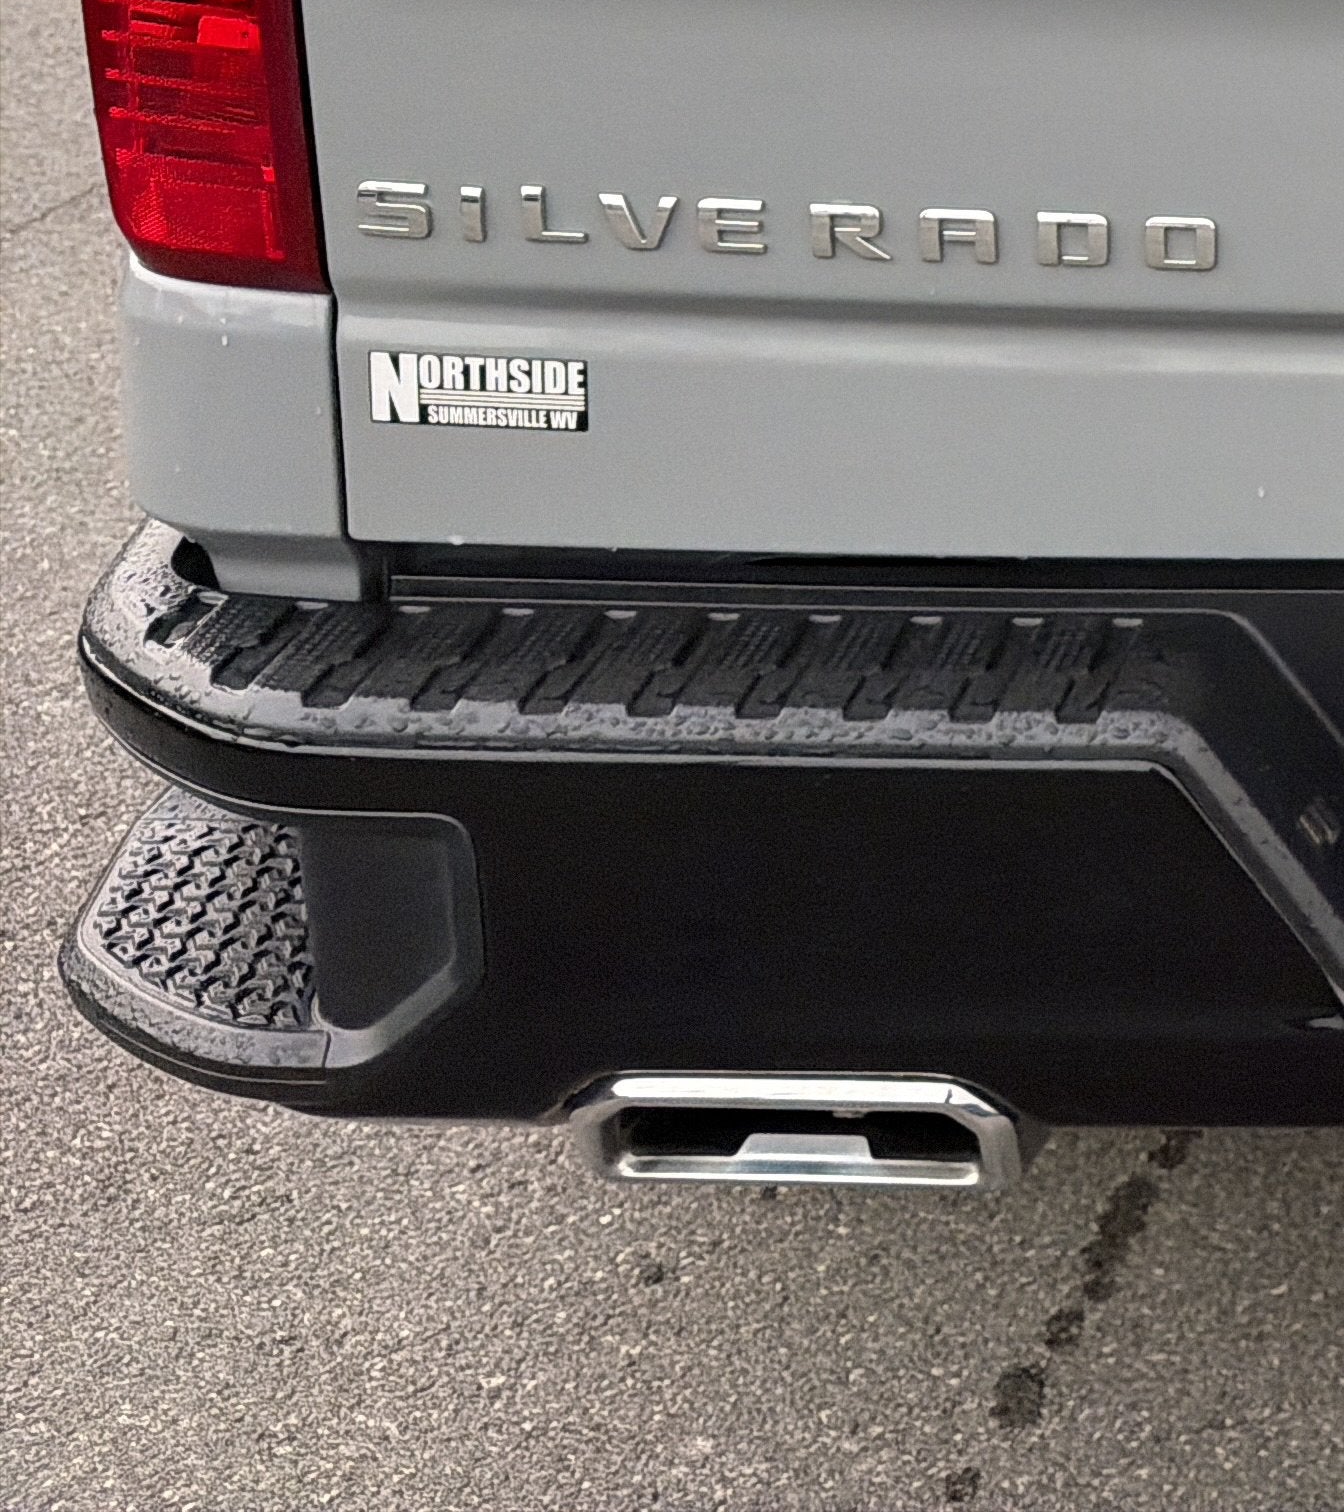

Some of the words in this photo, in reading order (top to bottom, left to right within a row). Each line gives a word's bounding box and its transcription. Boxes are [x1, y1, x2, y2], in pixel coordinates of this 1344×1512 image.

[356, 178, 1219, 271] SILVERADO
[369, 351, 586, 423] NORTHSIDE
[427, 405, 548, 428] SUMMERSVILLE
[549, 411, 578, 430] WV
